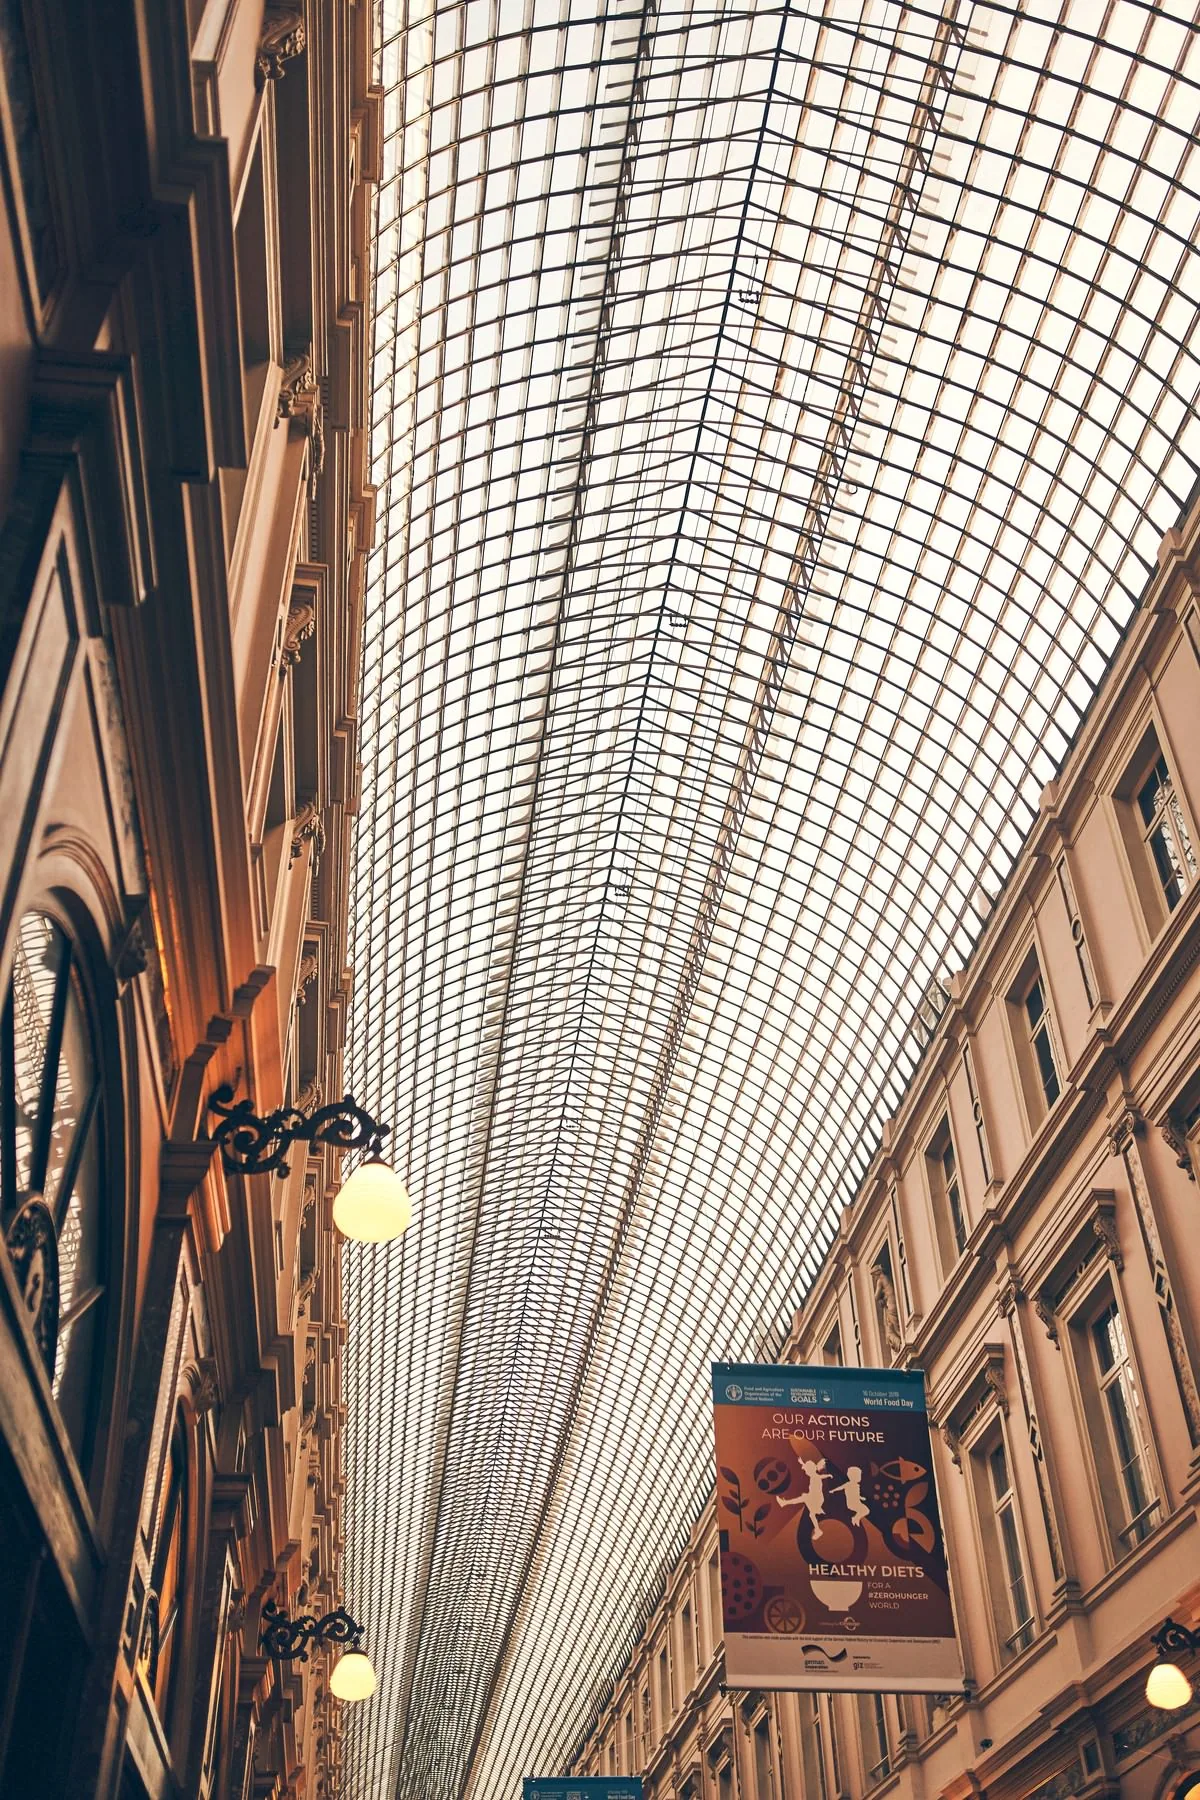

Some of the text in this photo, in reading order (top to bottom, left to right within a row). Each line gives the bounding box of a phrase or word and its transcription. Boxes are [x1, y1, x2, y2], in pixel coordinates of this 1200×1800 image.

[864, 1397, 882, 1406] World
[901, 1399, 913, 1408] Day
[772, 1413, 870, 1427] OUR ACTIONS
[762, 1428, 884, 1443] ARE OUR FUTURE
[809, 1564, 924, 1578] HEALTHY DIETS
